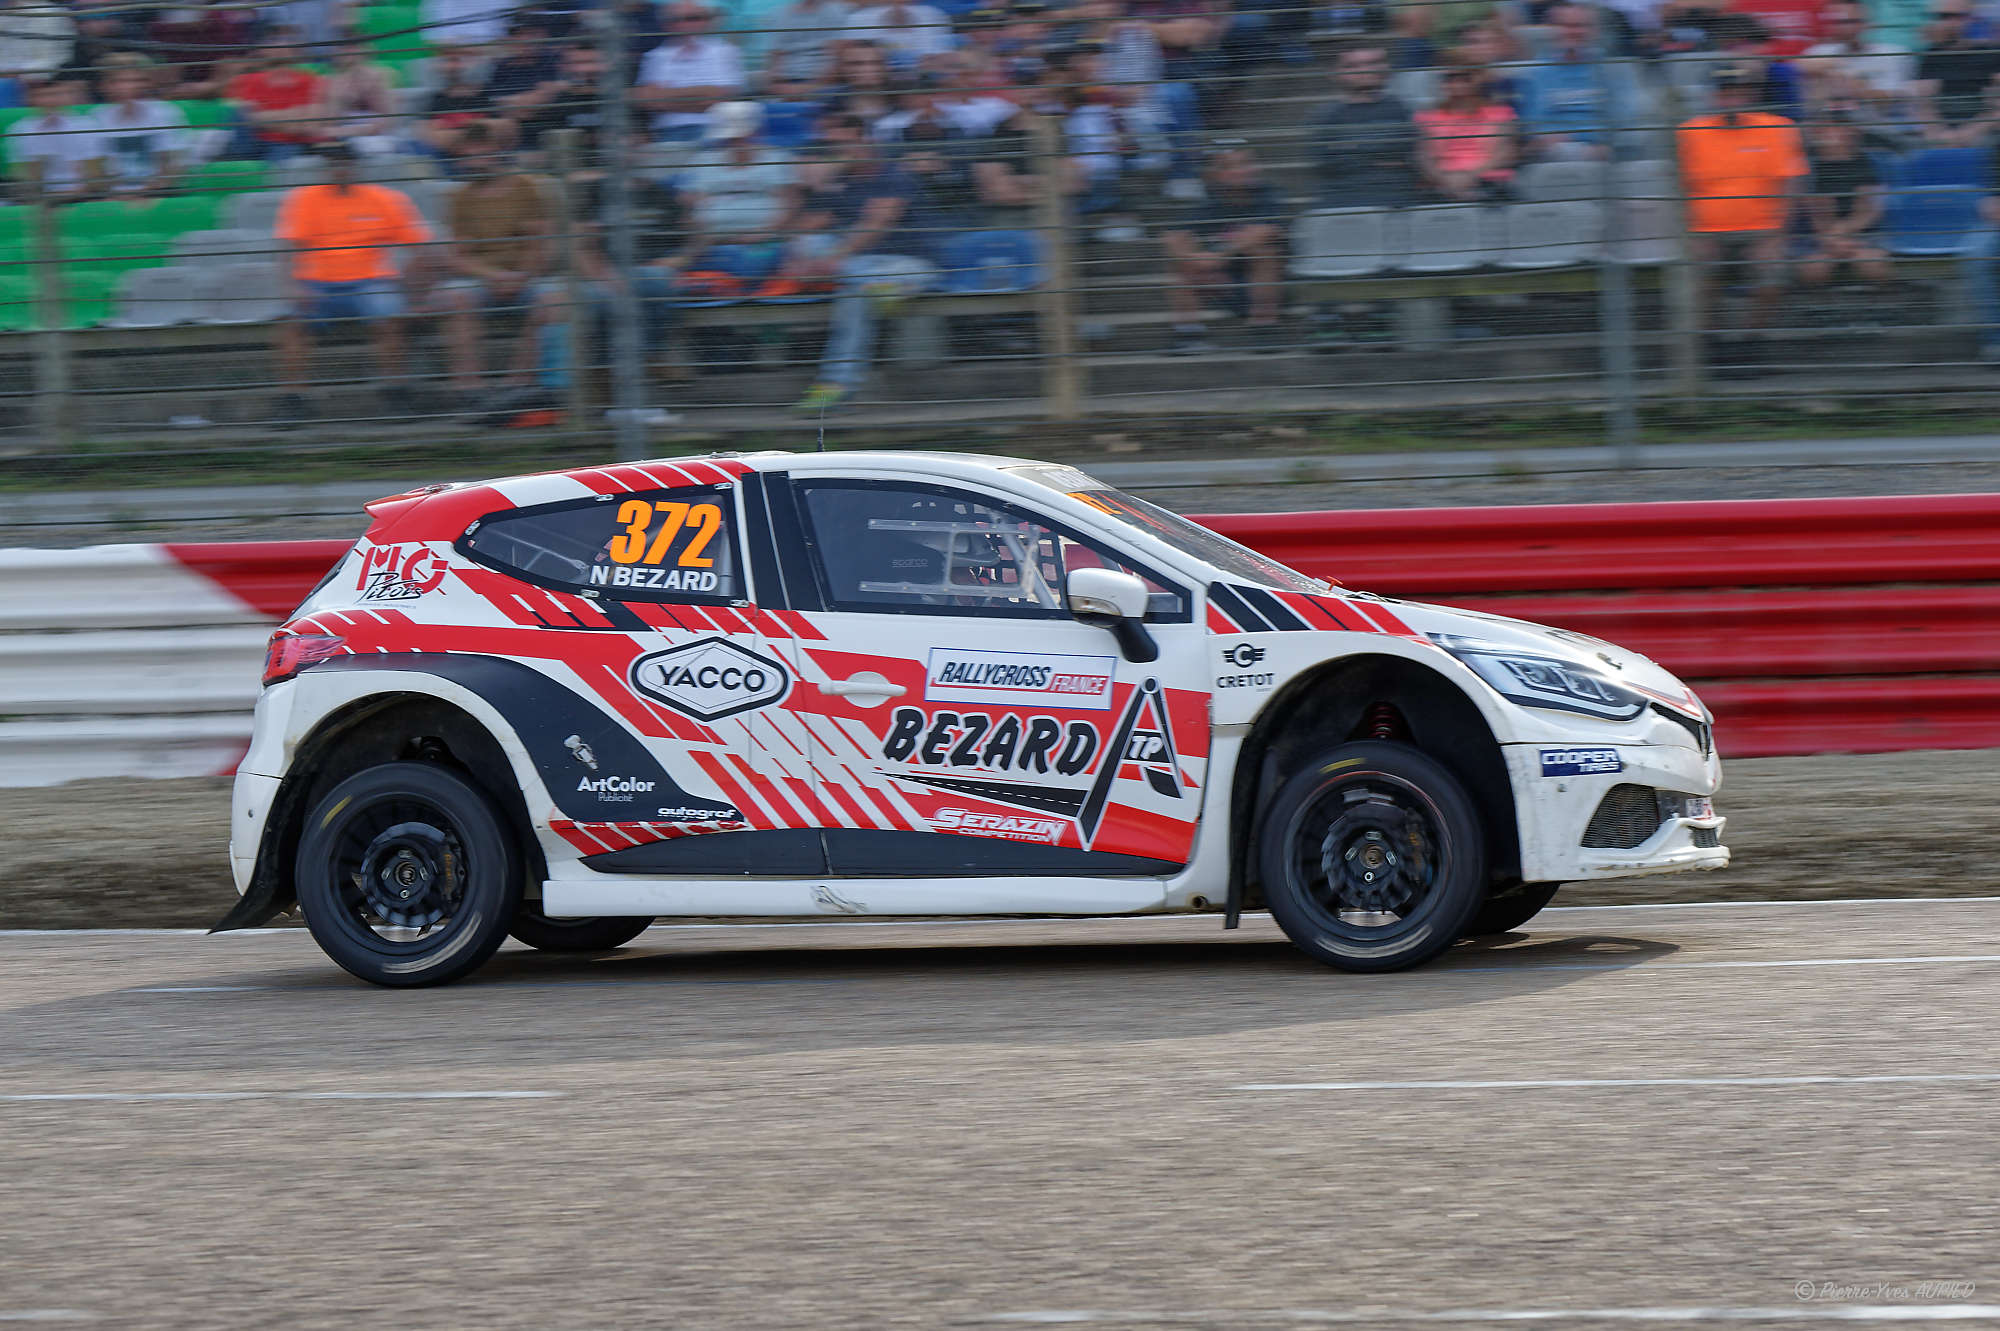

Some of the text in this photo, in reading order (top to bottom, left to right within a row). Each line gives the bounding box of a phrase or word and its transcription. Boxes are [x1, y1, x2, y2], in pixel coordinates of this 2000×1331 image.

[609, 500, 722, 568] 372
[589, 565, 719, 592] N BEZARD
[657, 664, 766, 693] YACCO
[939, 661, 1104, 695] RALLYCROSS FRANCE
[1217, 673, 1275, 688] CRETOT
[882, 707, 1099, 777] BEZARD
[1130, 735, 1163, 761] TP
[1543, 751, 1618, 765] COOPER
[1579, 761, 1620, 773] TIRES
[577, 776, 656, 792] ArtColor
[657, 807, 737, 820] autograf
[934, 807, 1066, 845] SERAZIN
